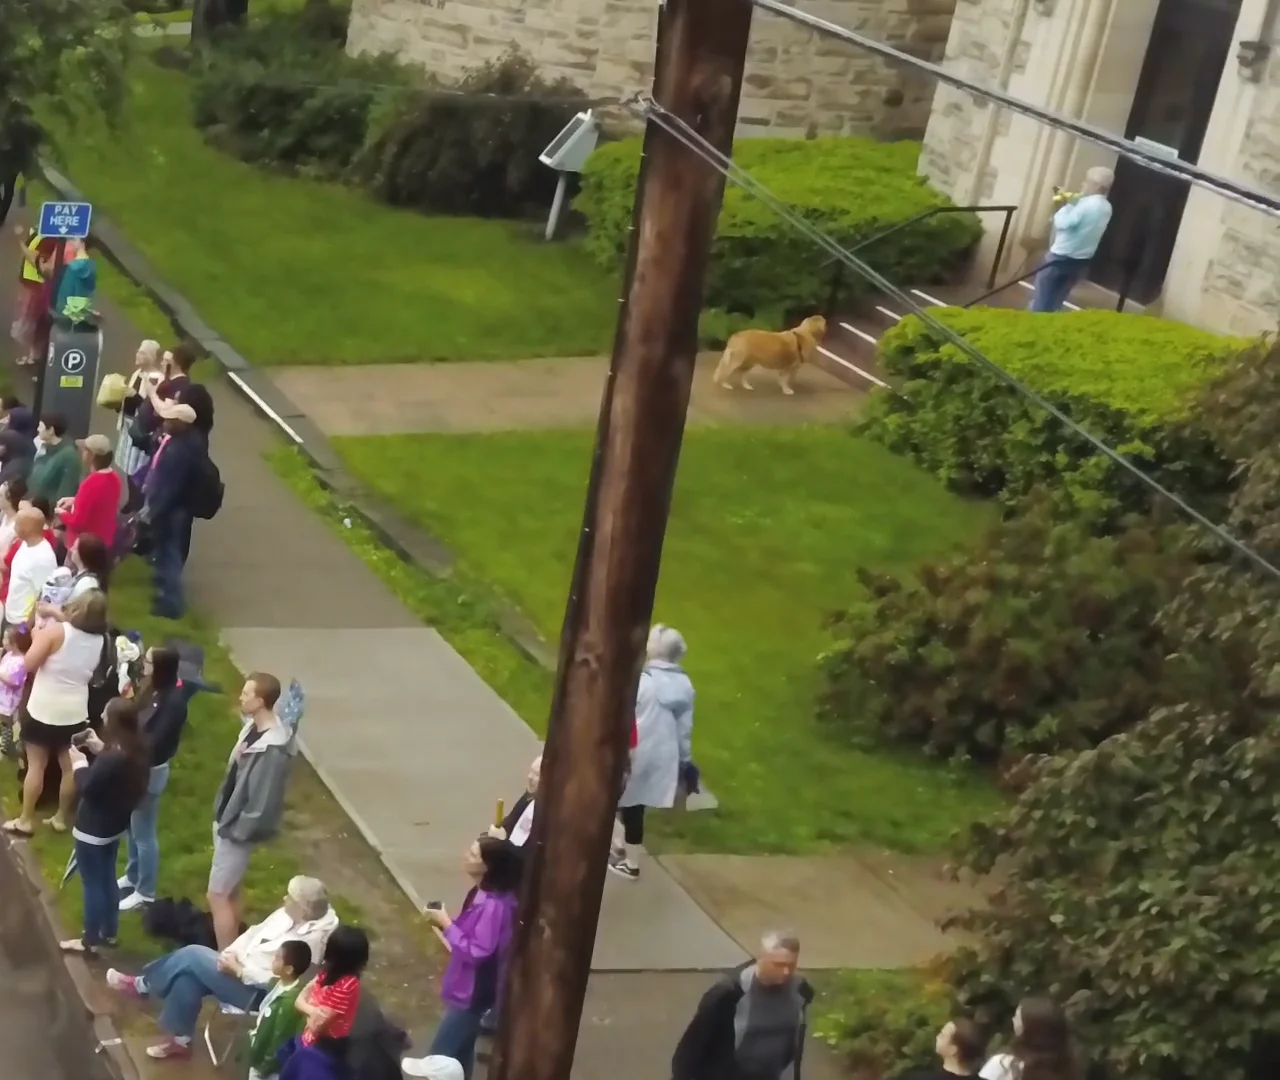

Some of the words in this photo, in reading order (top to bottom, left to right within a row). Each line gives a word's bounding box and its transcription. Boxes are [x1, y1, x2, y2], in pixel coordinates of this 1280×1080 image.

[54, 204, 79, 215] PAY
[50, 216, 80, 226] HERE
[68, 353, 81, 369] P
